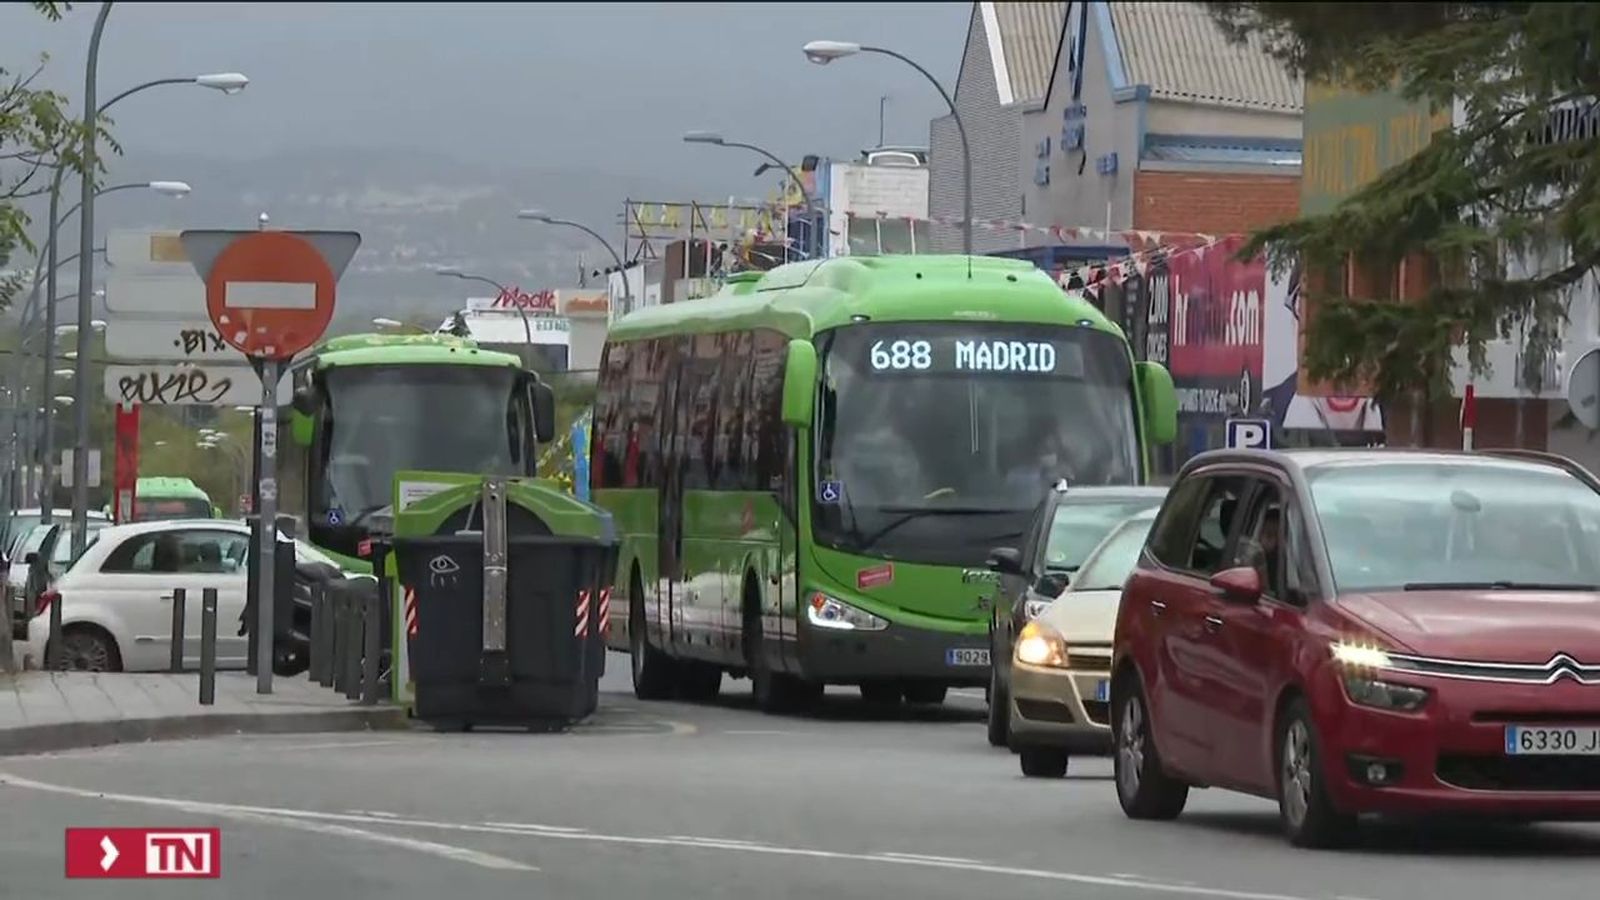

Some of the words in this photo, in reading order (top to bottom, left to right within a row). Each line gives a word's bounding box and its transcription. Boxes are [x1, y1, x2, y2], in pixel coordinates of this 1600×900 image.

[870, 340, 932, 370] 688
[955, 340, 1055, 372] MADRID
[1235, 424, 1264, 450] P
[955, 650, 989, 664] 9029
[1521, 730, 1577, 750] 6330
